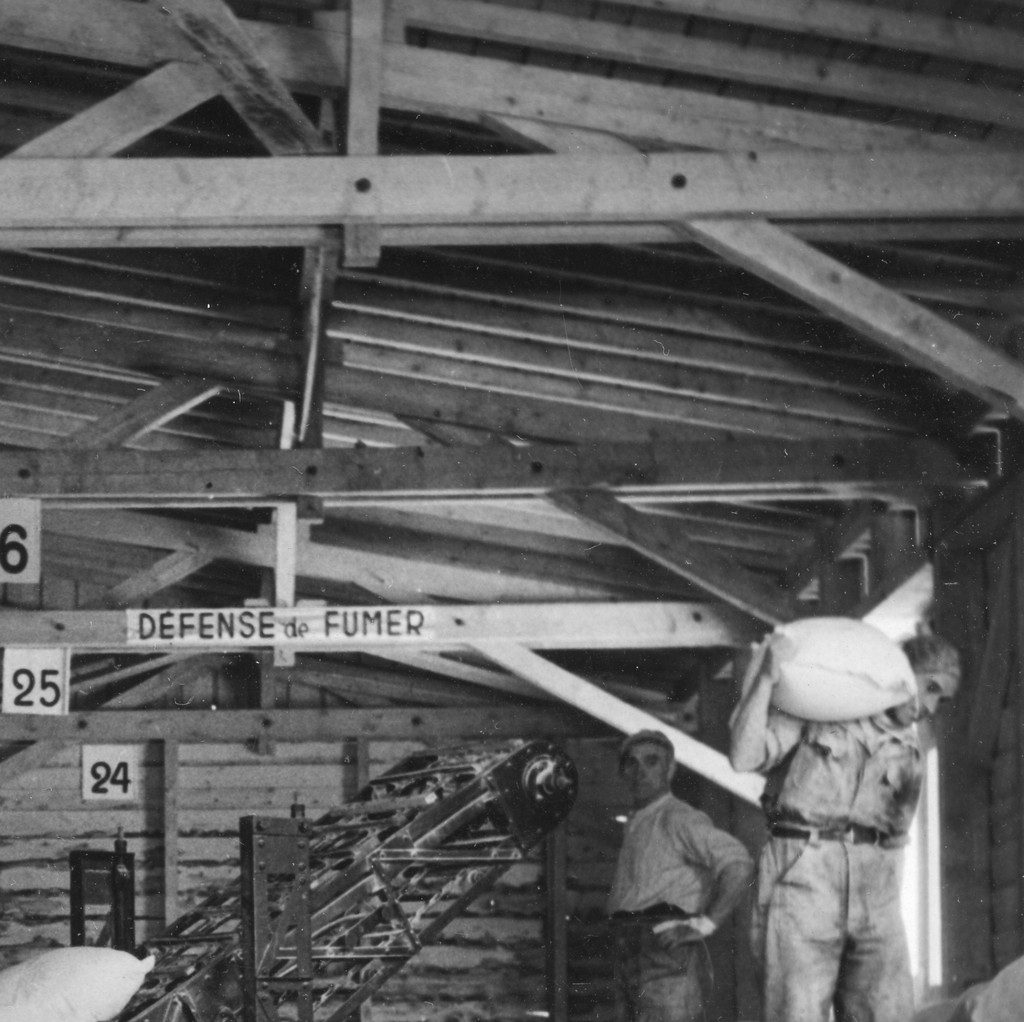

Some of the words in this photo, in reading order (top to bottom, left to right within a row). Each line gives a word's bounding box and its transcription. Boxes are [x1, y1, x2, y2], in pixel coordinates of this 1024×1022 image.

[137, 610, 275, 640] DÉFENSE
[284, 616, 310, 639] de
[323, 609, 425, 637] FUMER
[12, 668, 62, 708] 25
[90, 761, 132, 795] 24
